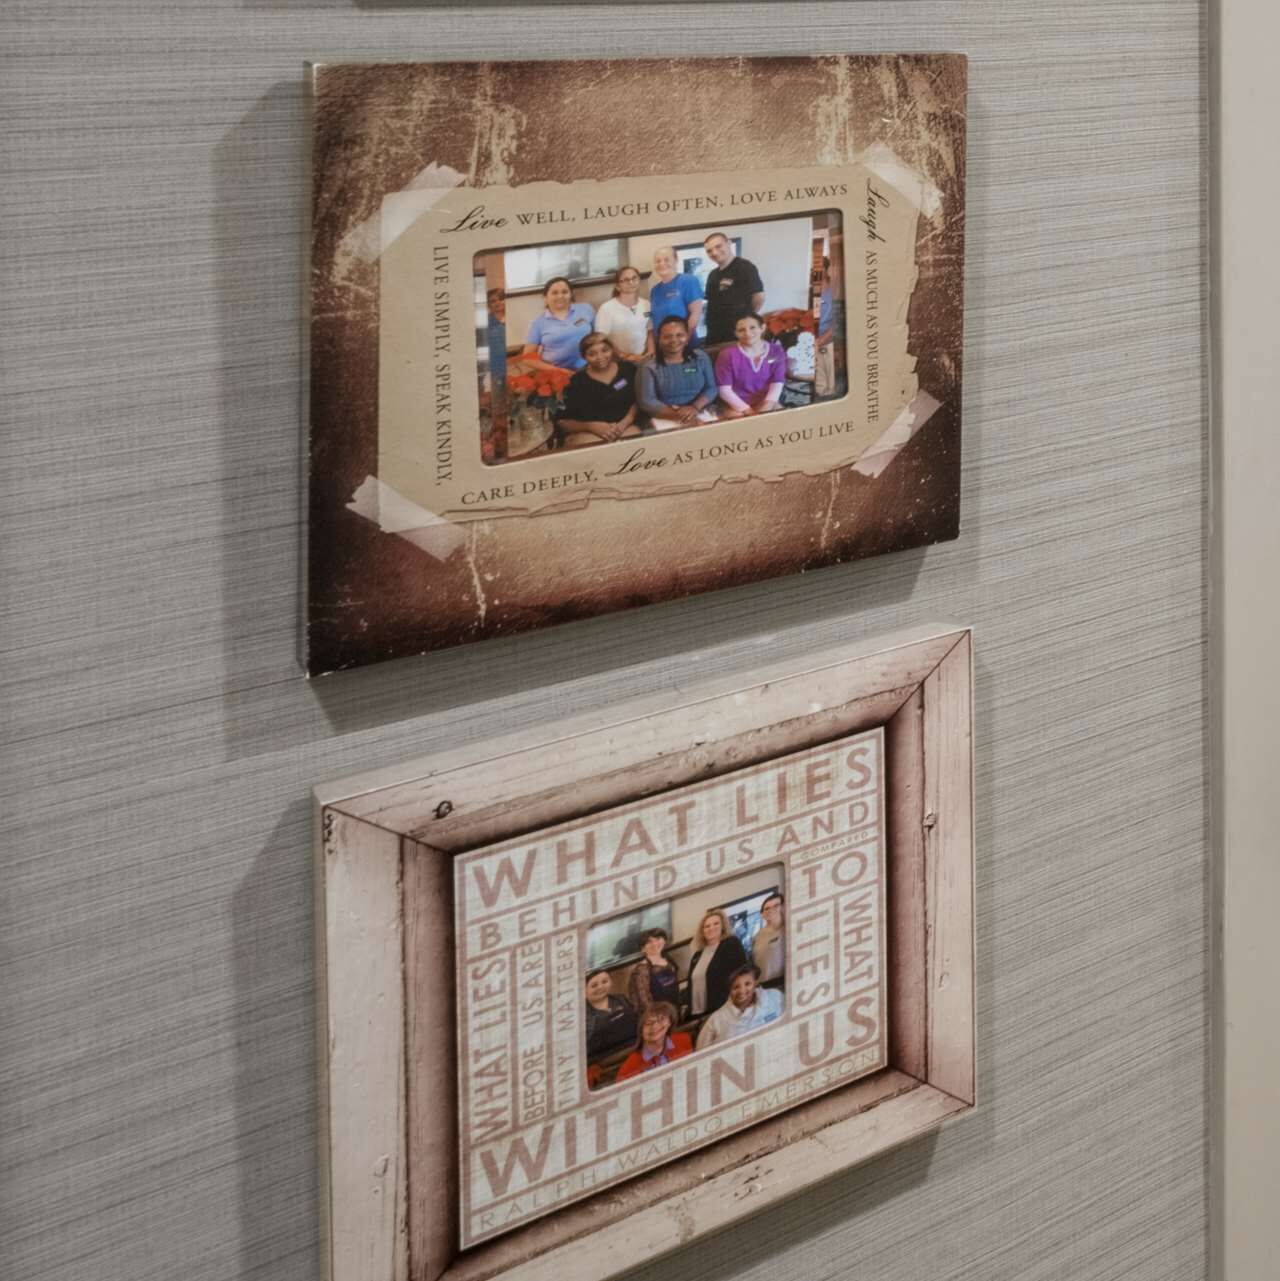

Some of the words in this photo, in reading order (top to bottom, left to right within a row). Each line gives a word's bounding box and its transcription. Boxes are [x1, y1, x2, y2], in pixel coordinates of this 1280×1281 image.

[440, 206, 507, 234] Live
[516, 210, 576, 226] WELL,
[584, 202, 649, 220] LAUGH
[656, 195, 723, 214] OFTEN,
[730, 189, 777, 207] LOVE
[784, 184, 848, 201] ALWAYS
[434, 245, 449, 284] LIVE
[866, 250, 878, 265] AS
[866, 268, 879, 310] MUCH
[434, 291, 450, 358] SIMPLY,
[866, 314, 879, 329] AS
[866, 331, 879, 359] YOU
[435, 364, 451, 415] SPEAK
[866, 363, 879, 423] BREATHE
[435, 420, 452, 487] KINDLY,
[461, 485, 515, 505] CARE
[523, 470, 598, 495] DEEPLY,
[604, 448, 668, 478] Love
[673, 452, 693, 466] AS
[699, 441, 748, 461] LONG
[754, 435, 774, 449] AS
[780, 429, 814, 445] YOU
[819, 421, 855, 439] LIVE
[472, 800, 696, 909] WHAT
[736, 747, 872, 827] LIES
[480, 864, 678, 951] BEHIND
[705, 838, 754, 875] US
[776, 800, 870, 853] AND
[802, 850, 868, 899] TO
[521, 940, 544, 989] ARE
[796, 909, 830, 1006] LIES
[843, 891, 873, 984] WHAT
[472, 958, 507, 1033] LIES
[522, 996, 544, 1028] US
[556, 935, 574, 1033] MATTERS
[473, 1043, 510, 1143] WHAT
[480, 1043, 756, 1199] WITHIN
[798, 995, 878, 1067] US
[523, 1043, 545, 1122] BEFORE
[558, 1055, 575, 1108] TINY
[480, 1162, 596, 1232] RALPH
[618, 1115, 723, 1170] WALDO
[742, 1048, 877, 1120] EMERSON
